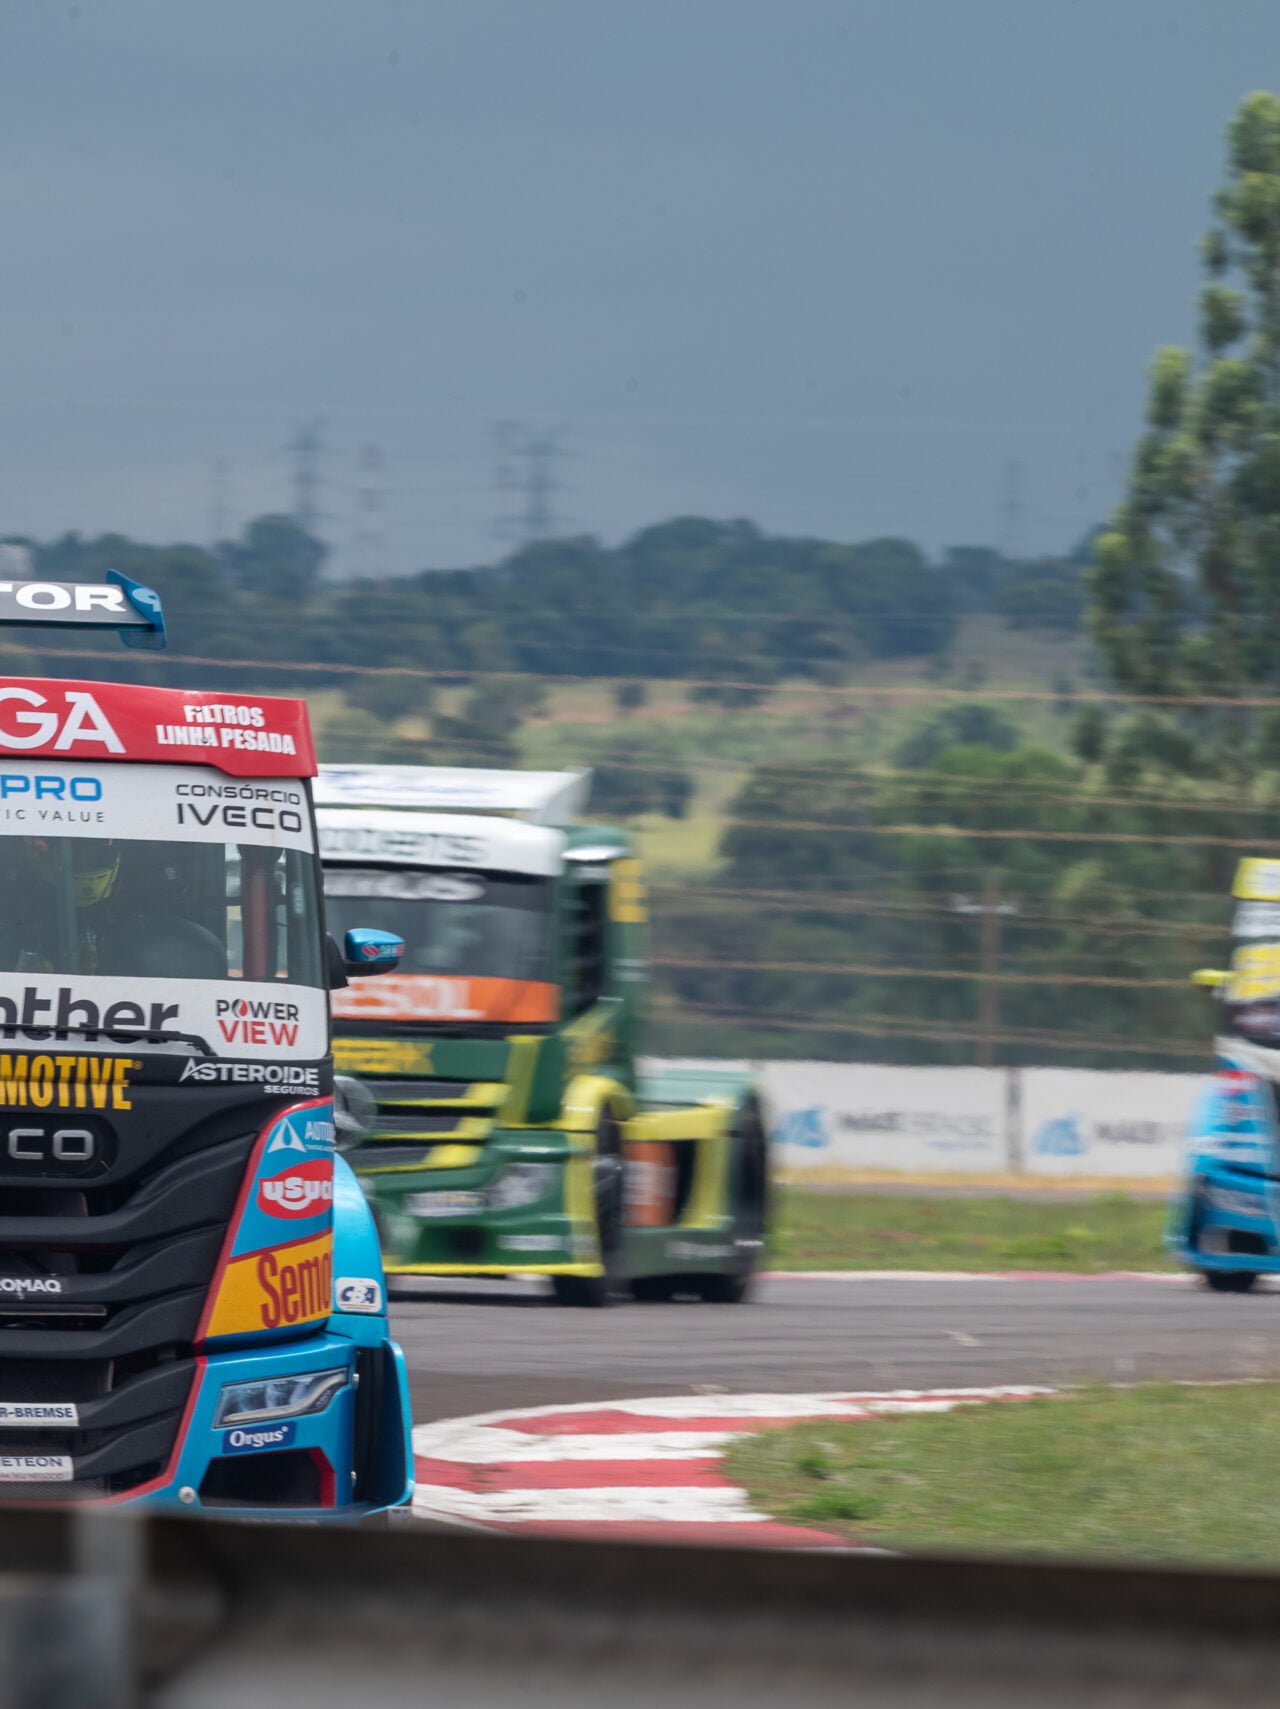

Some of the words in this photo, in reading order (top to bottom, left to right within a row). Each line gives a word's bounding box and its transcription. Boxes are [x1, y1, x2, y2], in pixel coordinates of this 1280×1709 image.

[183, 704, 265, 727] FILTROS
[156, 724, 219, 747] LINHA
[220, 728, 296, 755] PESADA
[176, 784, 300, 805] CONSÓRCIO
[39, 809, 105, 823] VALUE
[177, 803, 302, 832] IVECO
[216, 998, 299, 1021] POWER
[218, 1020, 298, 1047] VIEW
[178, 1057, 319, 1085] ASTEROIDE
[264, 1084, 319, 1096] SEGUROS
[229, 1429, 285, 1447] Orgus
